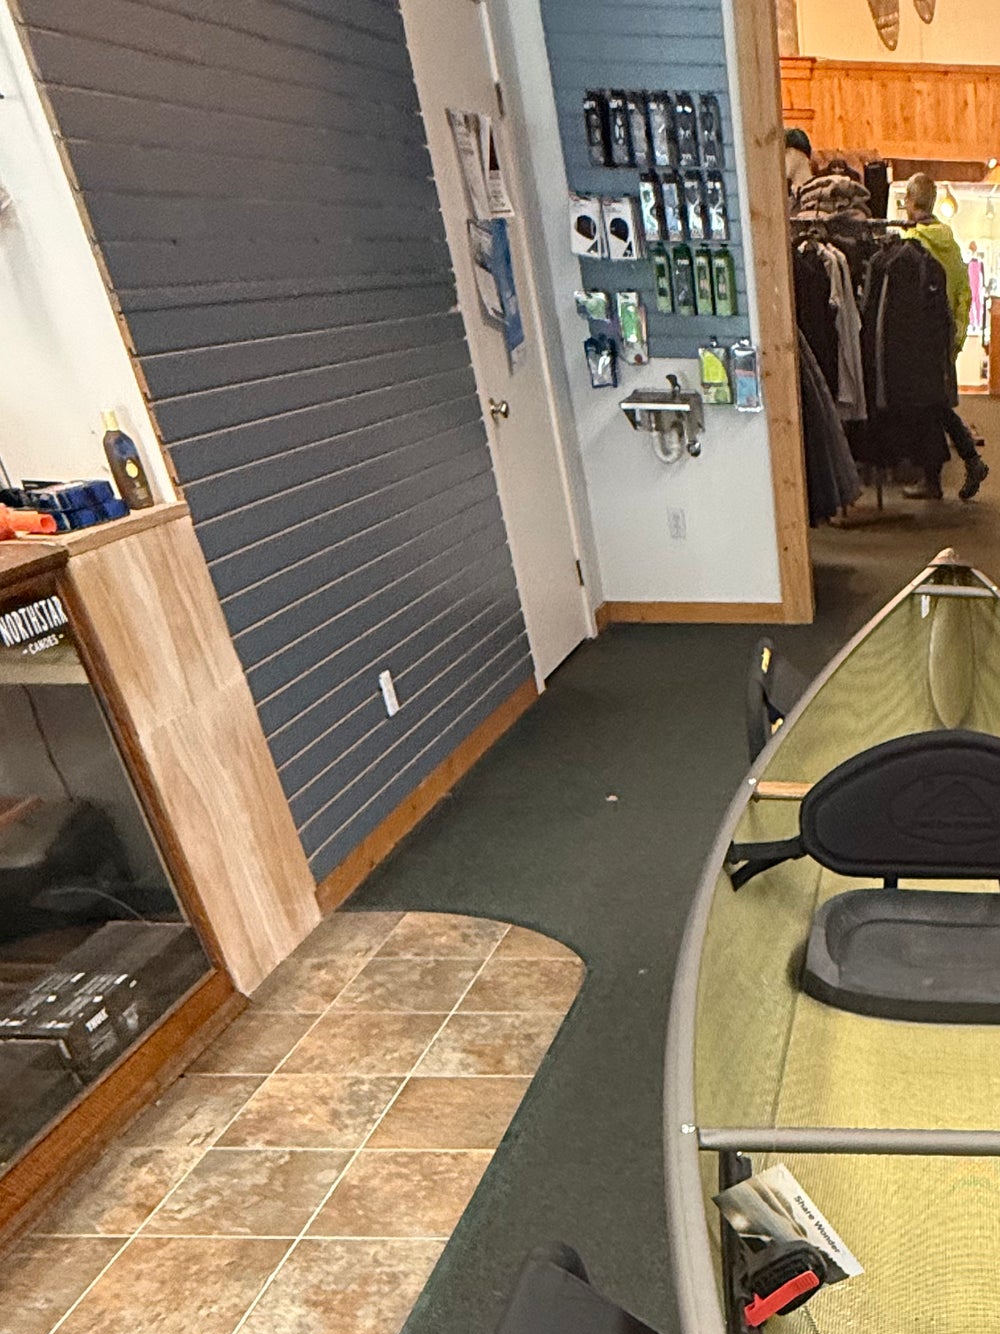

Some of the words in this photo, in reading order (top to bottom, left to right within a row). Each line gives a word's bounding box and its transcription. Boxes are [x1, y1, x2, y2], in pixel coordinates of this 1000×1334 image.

[0, 595, 69, 648] NORTHSTAR
[794, 1195, 815, 1221] Share
[814, 1220, 840, 1253] Wonder
